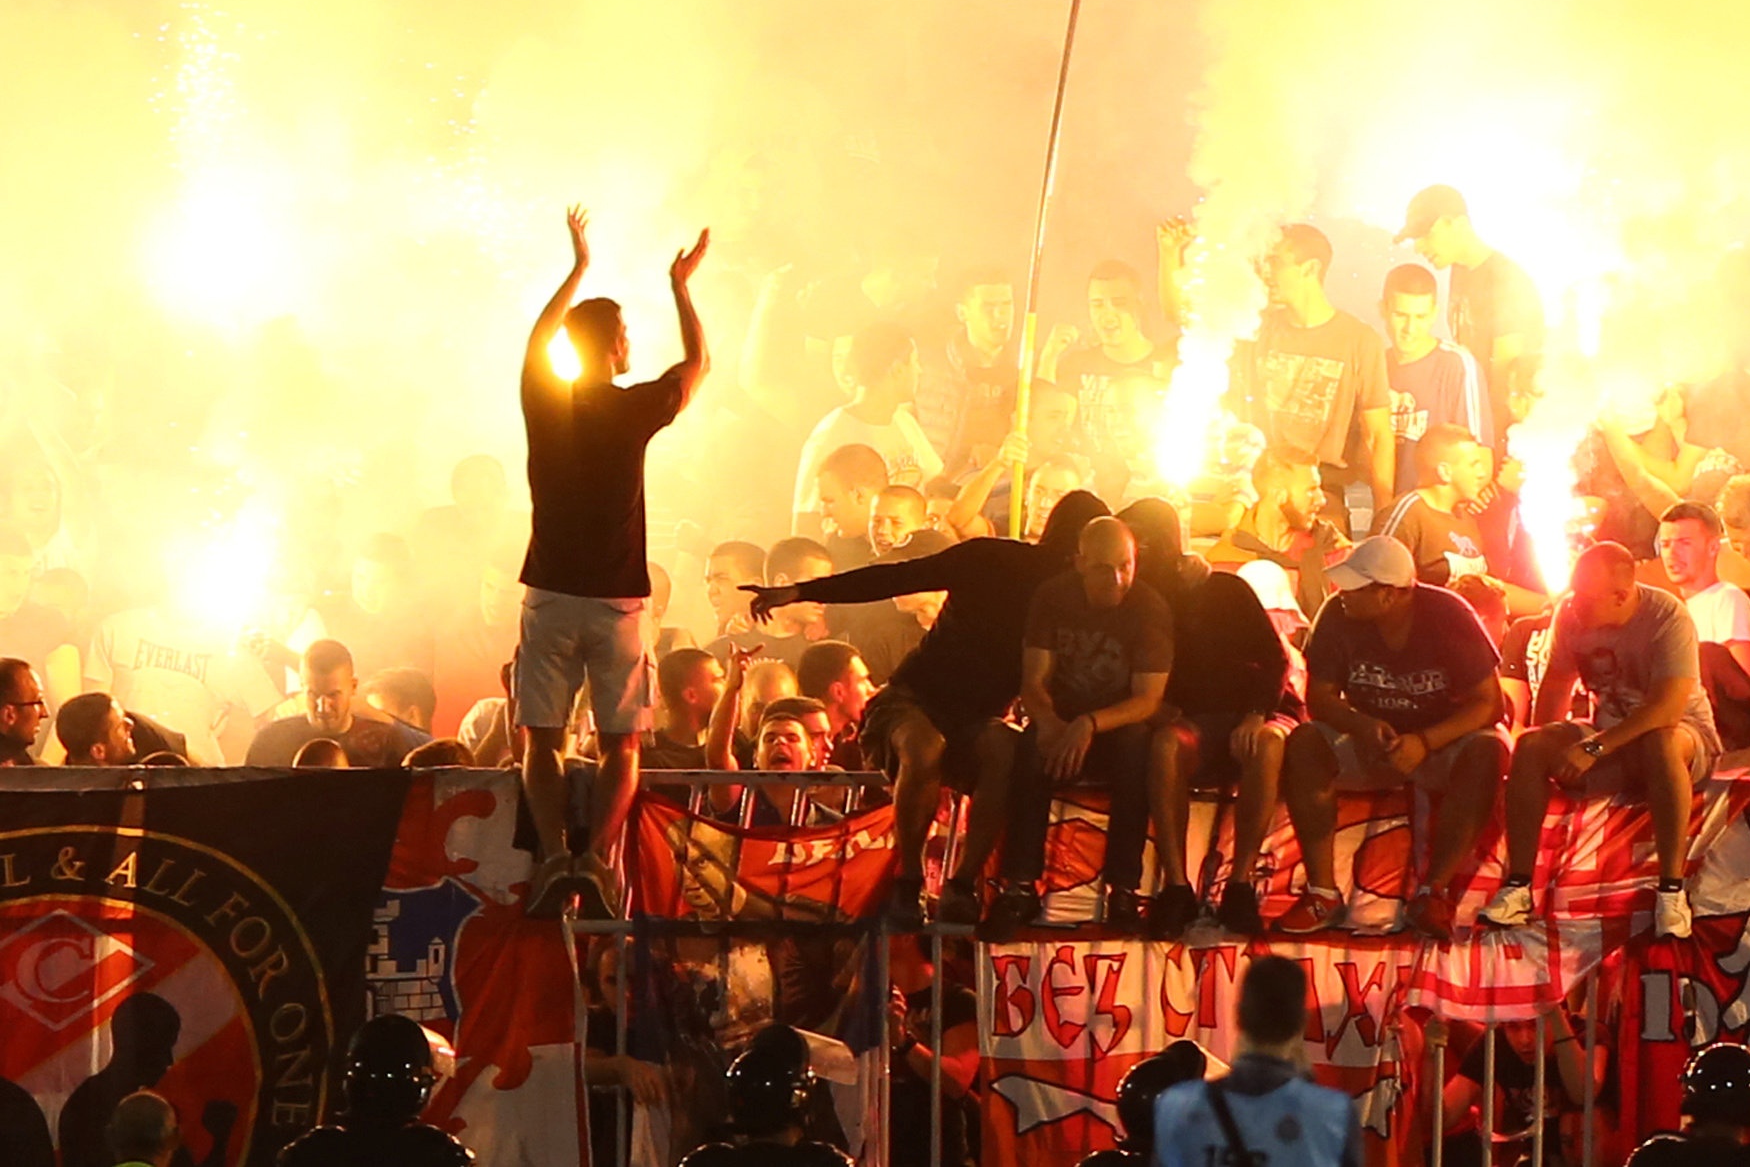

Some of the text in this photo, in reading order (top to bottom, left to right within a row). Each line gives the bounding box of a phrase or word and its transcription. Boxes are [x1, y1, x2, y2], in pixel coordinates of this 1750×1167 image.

[133, 638, 213, 685] EVERLAST
[104, 851, 207, 907] ALL
[203, 891, 290, 1002] FOR
[270, 1002, 314, 1127] ONE
[991, 944, 1133, 1058] БЕЗ
